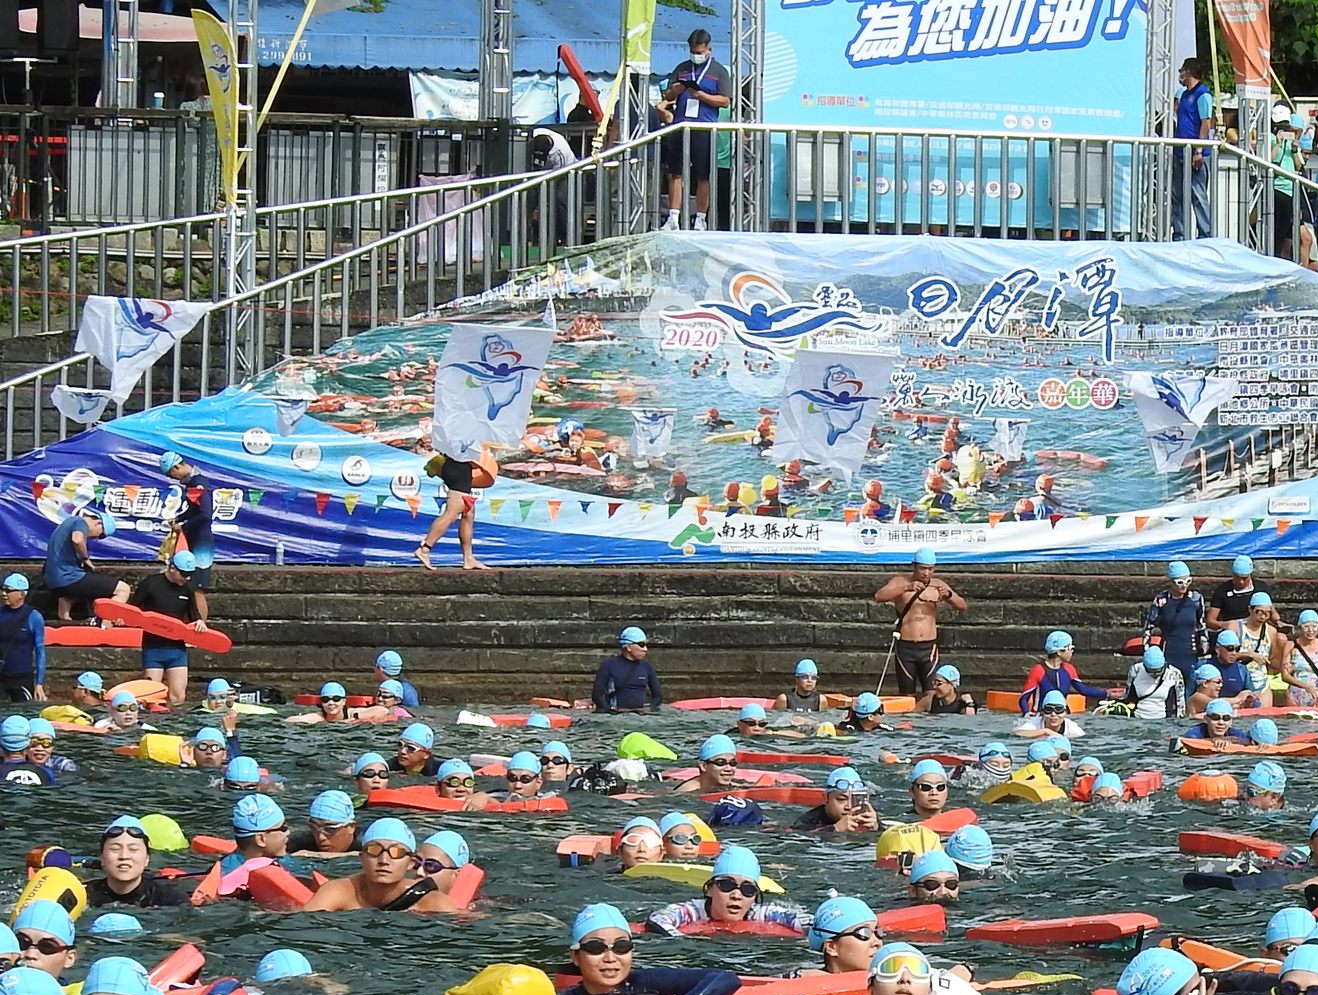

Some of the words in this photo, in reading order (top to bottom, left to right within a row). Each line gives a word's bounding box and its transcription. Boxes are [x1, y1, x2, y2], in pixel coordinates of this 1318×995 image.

[910, 257, 1121, 362] 日月潭
[665, 328, 718, 348] 2020
[1041, 381, 1117, 406] 嘉年華
[717, 522, 823, 541] 南投縣政府
[888, 529, 987, 543] 埔里鎮四季早泳會
